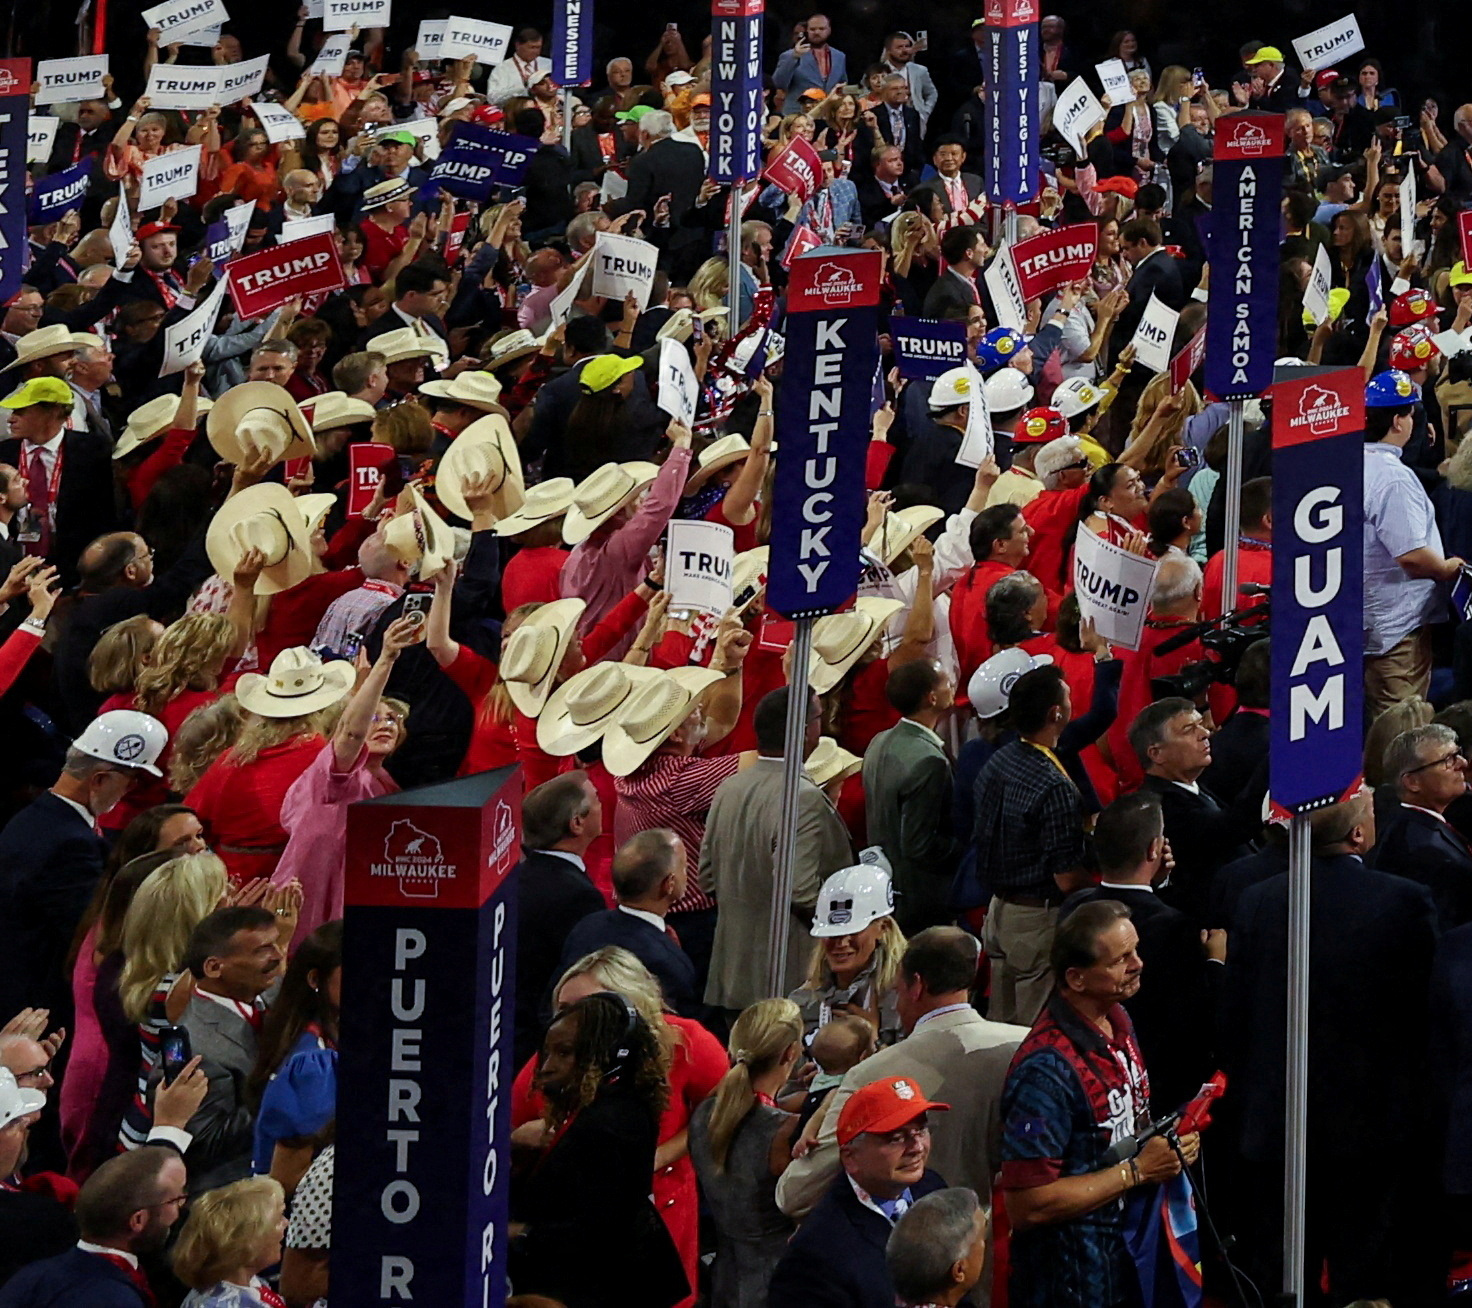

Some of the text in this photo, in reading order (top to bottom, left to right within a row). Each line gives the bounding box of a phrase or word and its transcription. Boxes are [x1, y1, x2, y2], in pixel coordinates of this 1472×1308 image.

[330, 0, 386, 14] TRUMP
[452, 31, 503, 48] TRUMP
[1303, 29, 1355, 60] TRUMP
[43, 68, 103, 87] TRUMP
[155, 79, 217, 94] TRUMP
[1104, 76, 1130, 89] TRUMP
[717, 21, 737, 175] NEW YORK
[746, 19, 760, 172] NEW YORK
[991, 32, 1001, 196] WEST VIRGINIA
[1016, 29, 1030, 195] WEST VIRGINIA
[1062, 95, 1090, 133] TRUMP
[1226, 140, 1272, 150] MILWAUKEE
[146, 164, 193, 189] TRUMP
[431, 160, 491, 182] TRUMP
[39, 174, 90, 206] TRUMP
[236, 251, 330, 290] TRUMP
[601, 254, 652, 280] TRUMP
[1020, 244, 1094, 274] TRUMP
[804, 284, 863, 296] MILWAUKEE
[1231, 165, 1257, 385] AMERICAN SAMOA
[897, 335, 964, 358] TRUMP
[1291, 406, 1349, 427] MILWAUKEE
[798, 319, 847, 594] KENTUCKY
[1076, 557, 1139, 608] TRUMP
[1290, 486, 1345, 742] GUAM
[371, 864, 456, 879] MILWAUKEE
[481, 901, 505, 1196] PUERTO
[380, 928, 426, 1224] PUERTO
